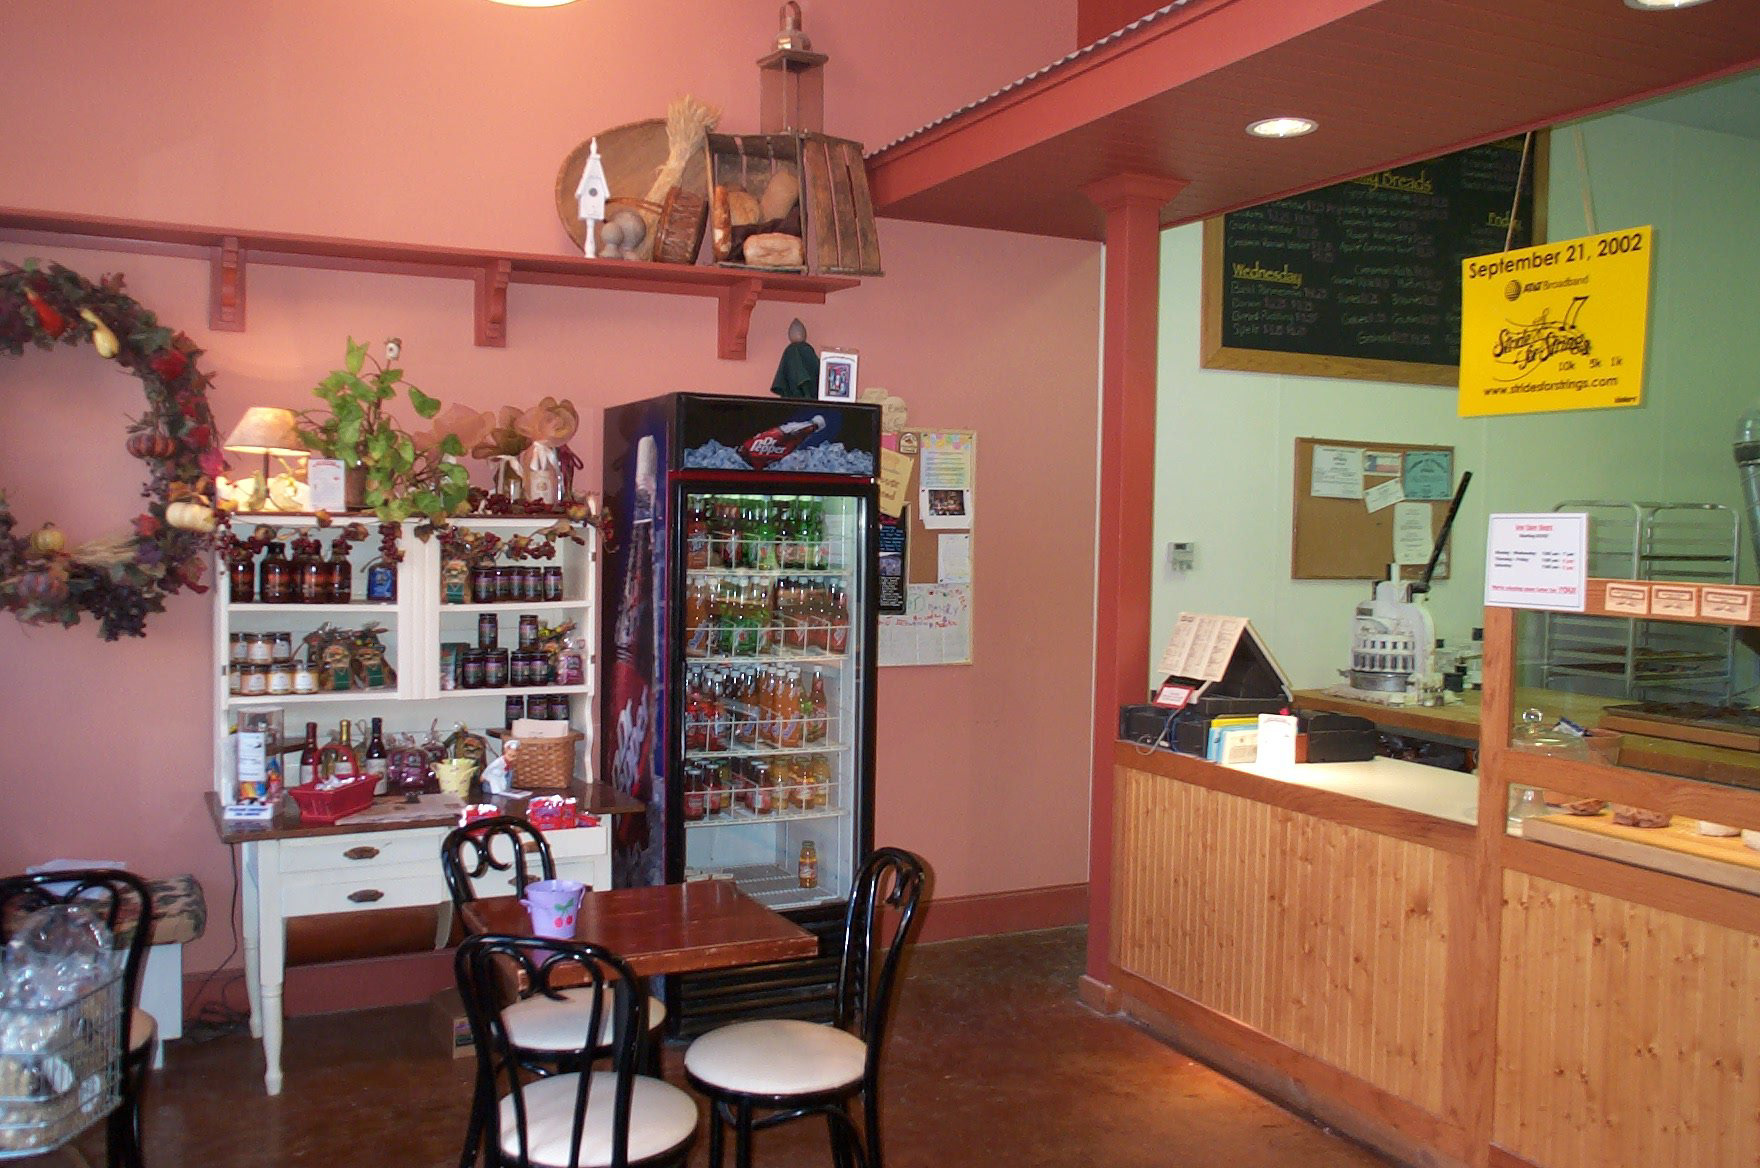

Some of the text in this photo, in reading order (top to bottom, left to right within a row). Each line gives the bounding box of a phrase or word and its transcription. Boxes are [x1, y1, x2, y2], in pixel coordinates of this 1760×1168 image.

[1469, 233, 1643, 279] September 21, 2002
[1231, 261, 1303, 289] Wednesday
[1559, 361, 1575, 372] 10k
[751, 440, 786, 456] Pepper
